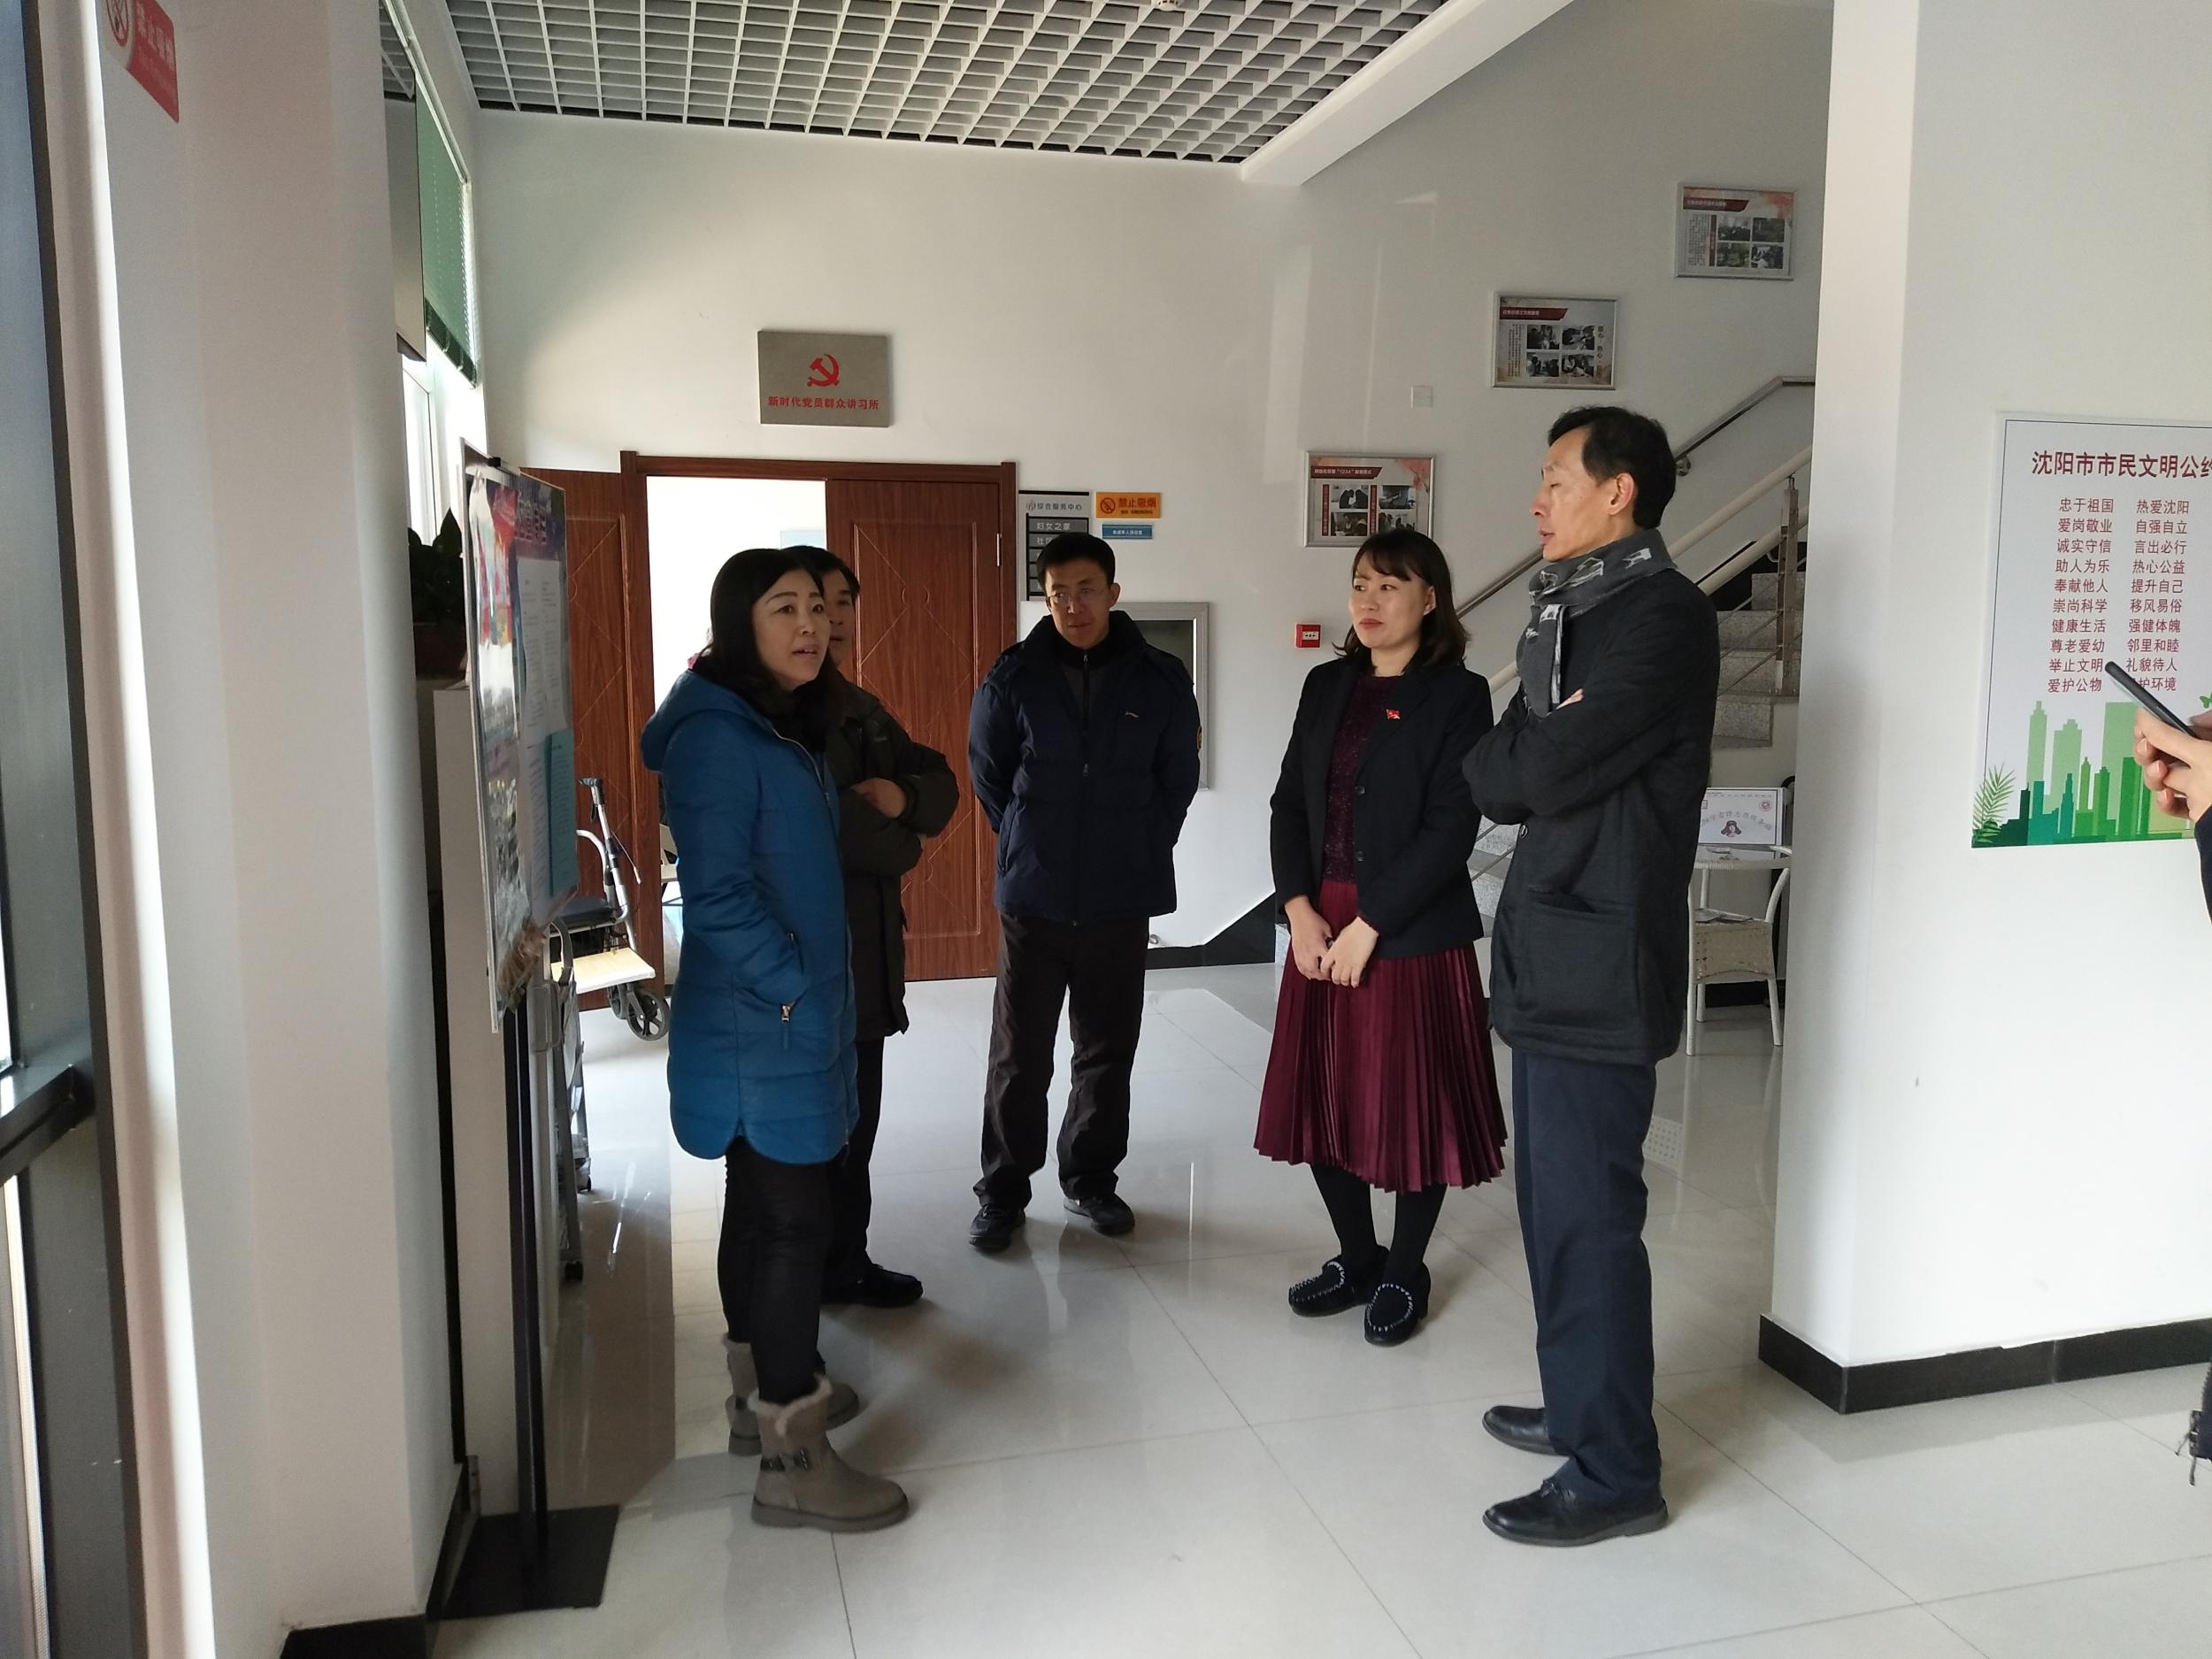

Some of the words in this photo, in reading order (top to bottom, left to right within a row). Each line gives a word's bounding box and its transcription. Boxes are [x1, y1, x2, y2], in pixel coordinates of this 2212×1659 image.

[1118, 496, 1157, 508] 禁止吸烟
[2059, 496, 2114, 513] 忠于祖国
[2136, 498, 2190, 515] 热爱沈阳
[1036, 522, 1071, 532] 妇女之家
[2057, 518, 2113, 534] 爱岗敬业
[2136, 518, 2188, 534] 自强自立
[2056, 537, 2112, 554] 诚实守信
[2134, 539, 2187, 555] 言出必行
[2055, 558, 2110, 574] 助人为乐
[2132, 558, 2186, 574] 热心公益
[2054, 578, 2108, 594] 奉献他人
[2131, 579, 2184, 594] 提升自己
[2053, 598, 2108, 613] 崇尚科学
[2130, 598, 2183, 614] 移风易俗
[2051, 618, 2107, 634] 健康生活
[2128, 618, 2181, 634] 强健体魄
[2050, 638, 2105, 654] 尊老爱幼
[2126, 638, 2179, 653] 邻里和睦
[2048, 657, 2103, 673] 举止文明
[2125, 657, 2177, 672] 礼貌待人
[2047, 677, 2102, 693] 爱护公物
[2133, 676, 2177, 692] 护环境
